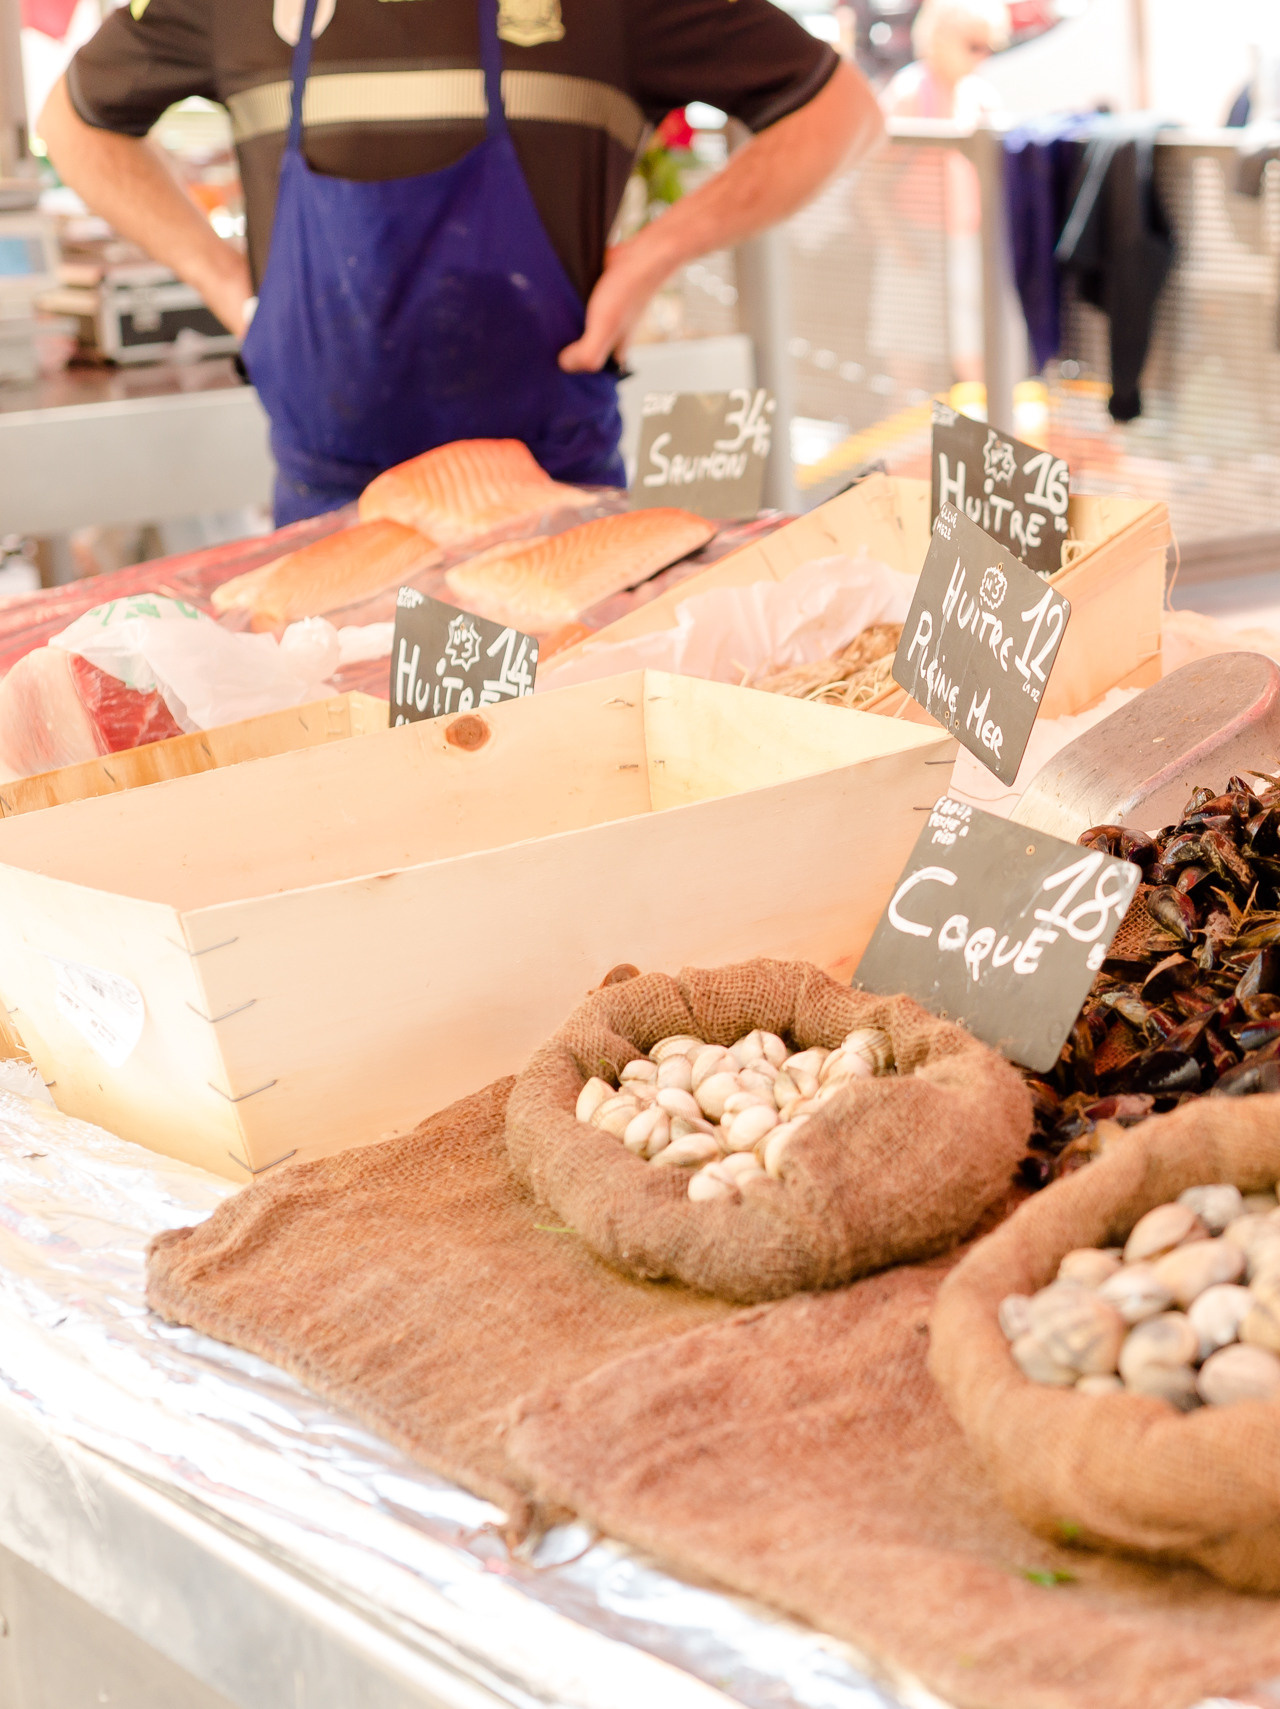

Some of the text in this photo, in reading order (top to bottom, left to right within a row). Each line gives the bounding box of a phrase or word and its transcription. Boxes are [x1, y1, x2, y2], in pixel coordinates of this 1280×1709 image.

[643, 432, 748, 487] SAUMON
[1023, 453, 1069, 515] 16
[942, 556, 1014, 672] HUITRE
[1015, 586, 1064, 682] 12
[907, 610, 1004, 759] PLEINE MER
[888, 866, 1059, 981] COQUE
[1034, 852, 1138, 942] 18
